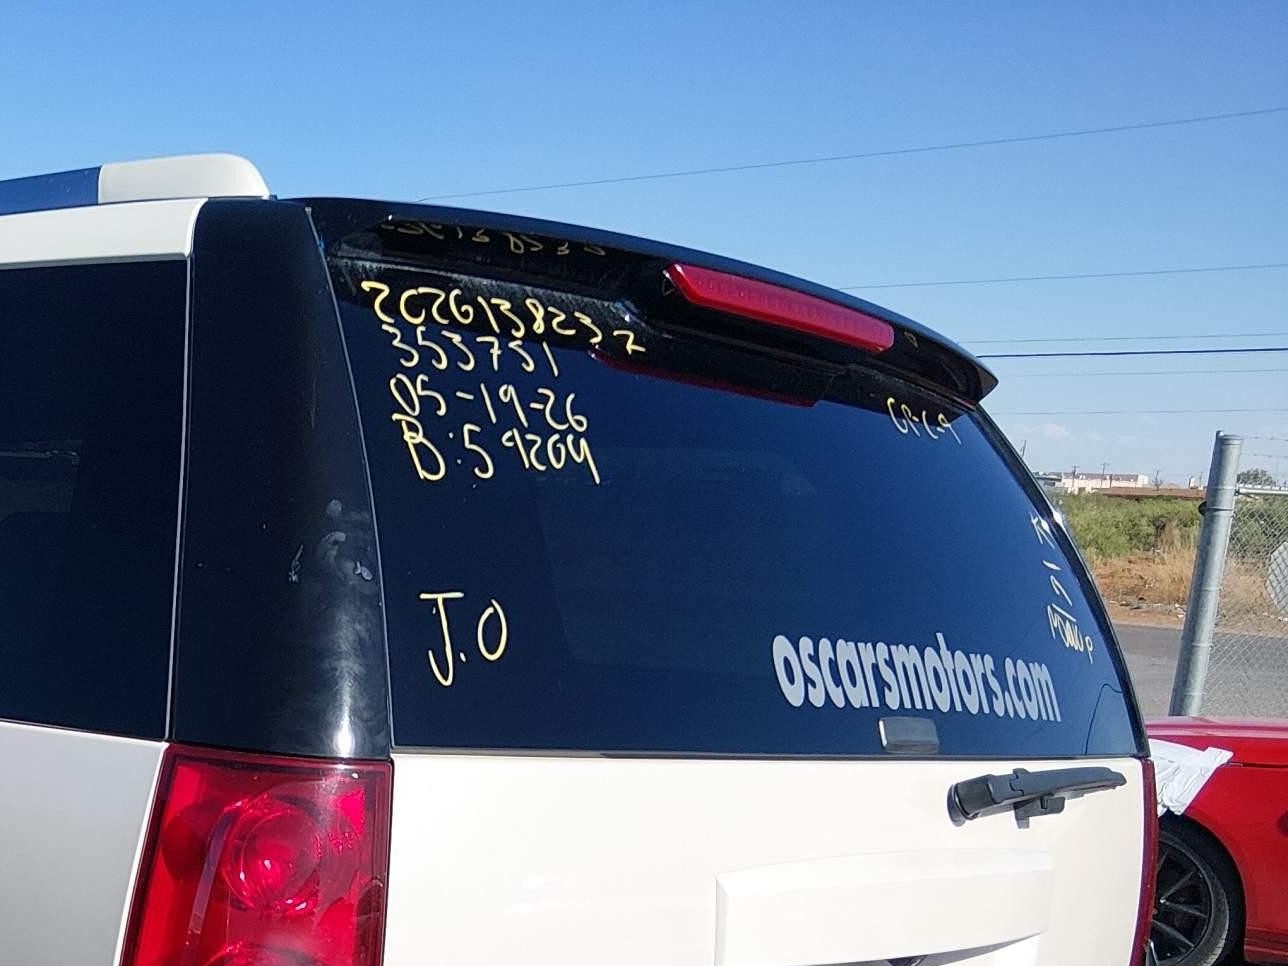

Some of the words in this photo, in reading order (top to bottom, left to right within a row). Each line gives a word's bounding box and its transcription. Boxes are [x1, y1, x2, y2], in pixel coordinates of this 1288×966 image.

[381, 323, 560, 378] 353751
[389, 372, 590, 434] 05-19-26
[772, 632, 1062, 722] oscarsmotors.com
